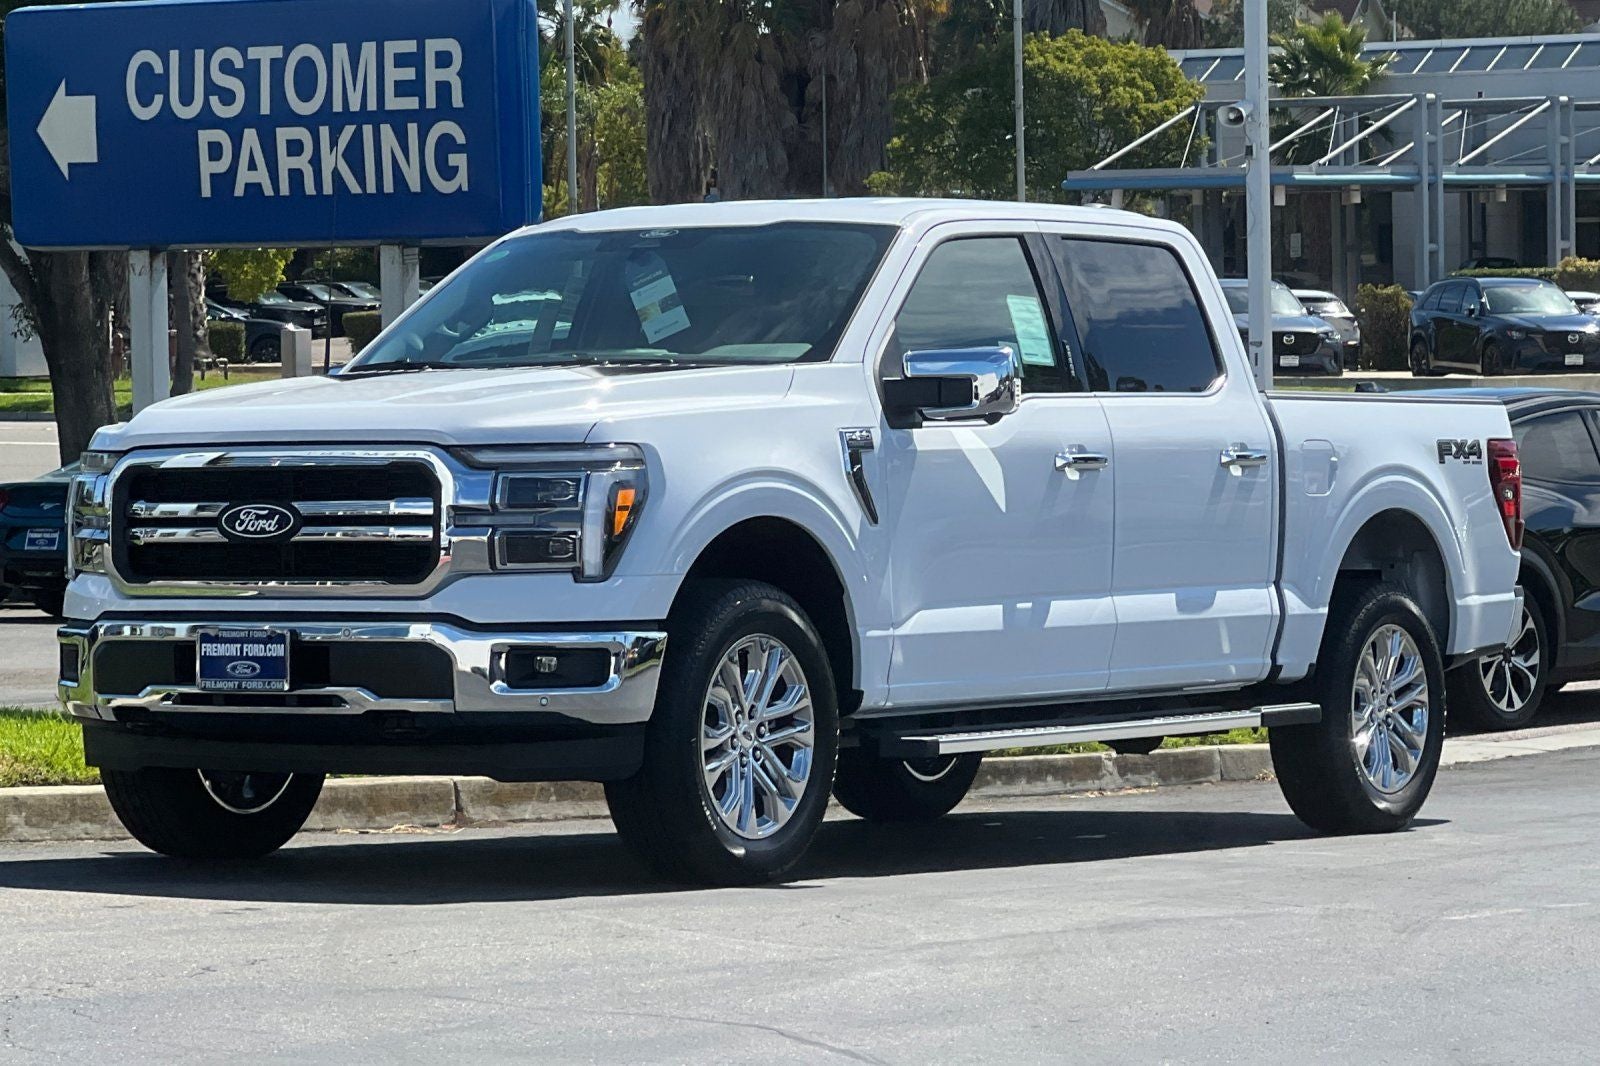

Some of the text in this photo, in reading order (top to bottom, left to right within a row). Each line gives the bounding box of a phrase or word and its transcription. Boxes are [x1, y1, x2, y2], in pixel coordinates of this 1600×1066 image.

[126, 37, 464, 120] CUSTOMER
[197, 120, 469, 198] PARKING
[1436, 439, 1482, 464] FX4
[235, 508, 280, 531] Ford
[219, 630, 267, 638] FREMONT FORD
[201, 643, 285, 657] FREMONT FORD.COM
[235, 664, 252, 674] Ford
[201, 680, 239, 689] FREMONT
